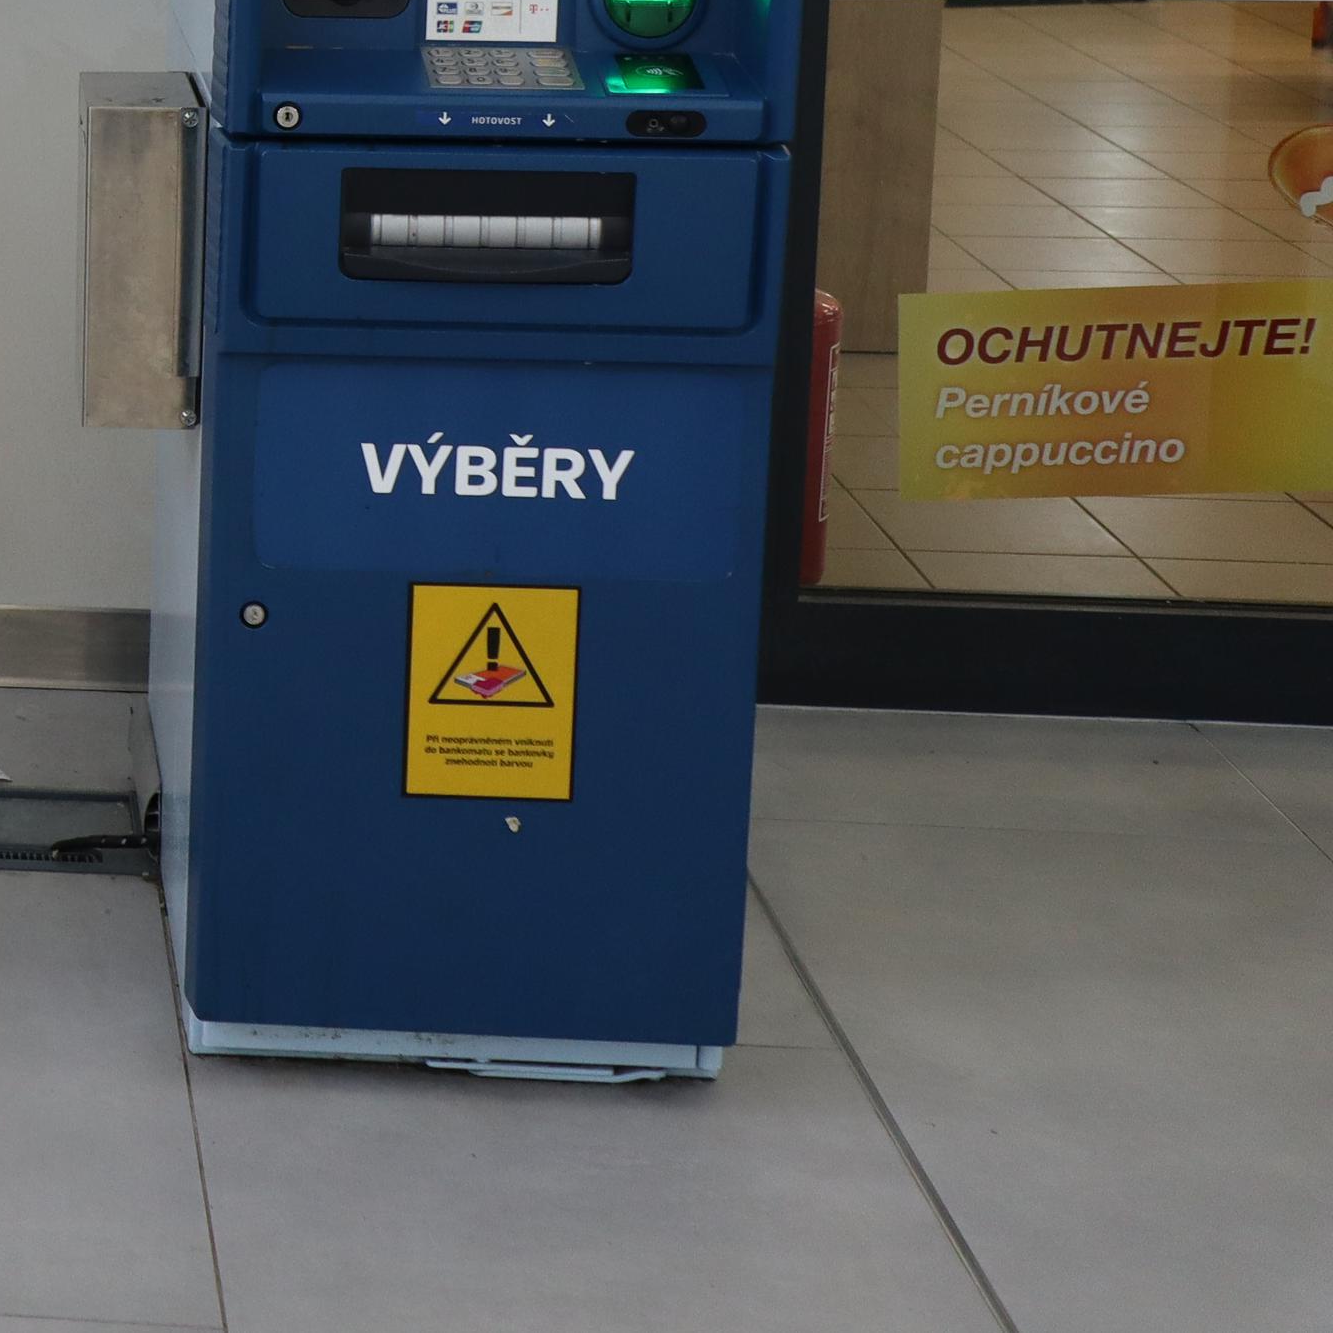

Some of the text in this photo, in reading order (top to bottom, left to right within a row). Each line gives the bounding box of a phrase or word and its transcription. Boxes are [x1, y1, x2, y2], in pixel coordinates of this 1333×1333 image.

[471, 114, 523, 126] HOTOVOST
[936, 318, 1318, 367] OCHUTNEJTE!
[935, 381, 1151, 419] Perníkové
[360, 431, 635, 501] VÝBĚRY
[935, 432, 1186, 475] cappuccino
[424, 745, 437, 754] do
[439, 746, 493, 756] bankomatu
[507, 748, 555, 759] bankovky
[426, 734, 439, 743] Při
